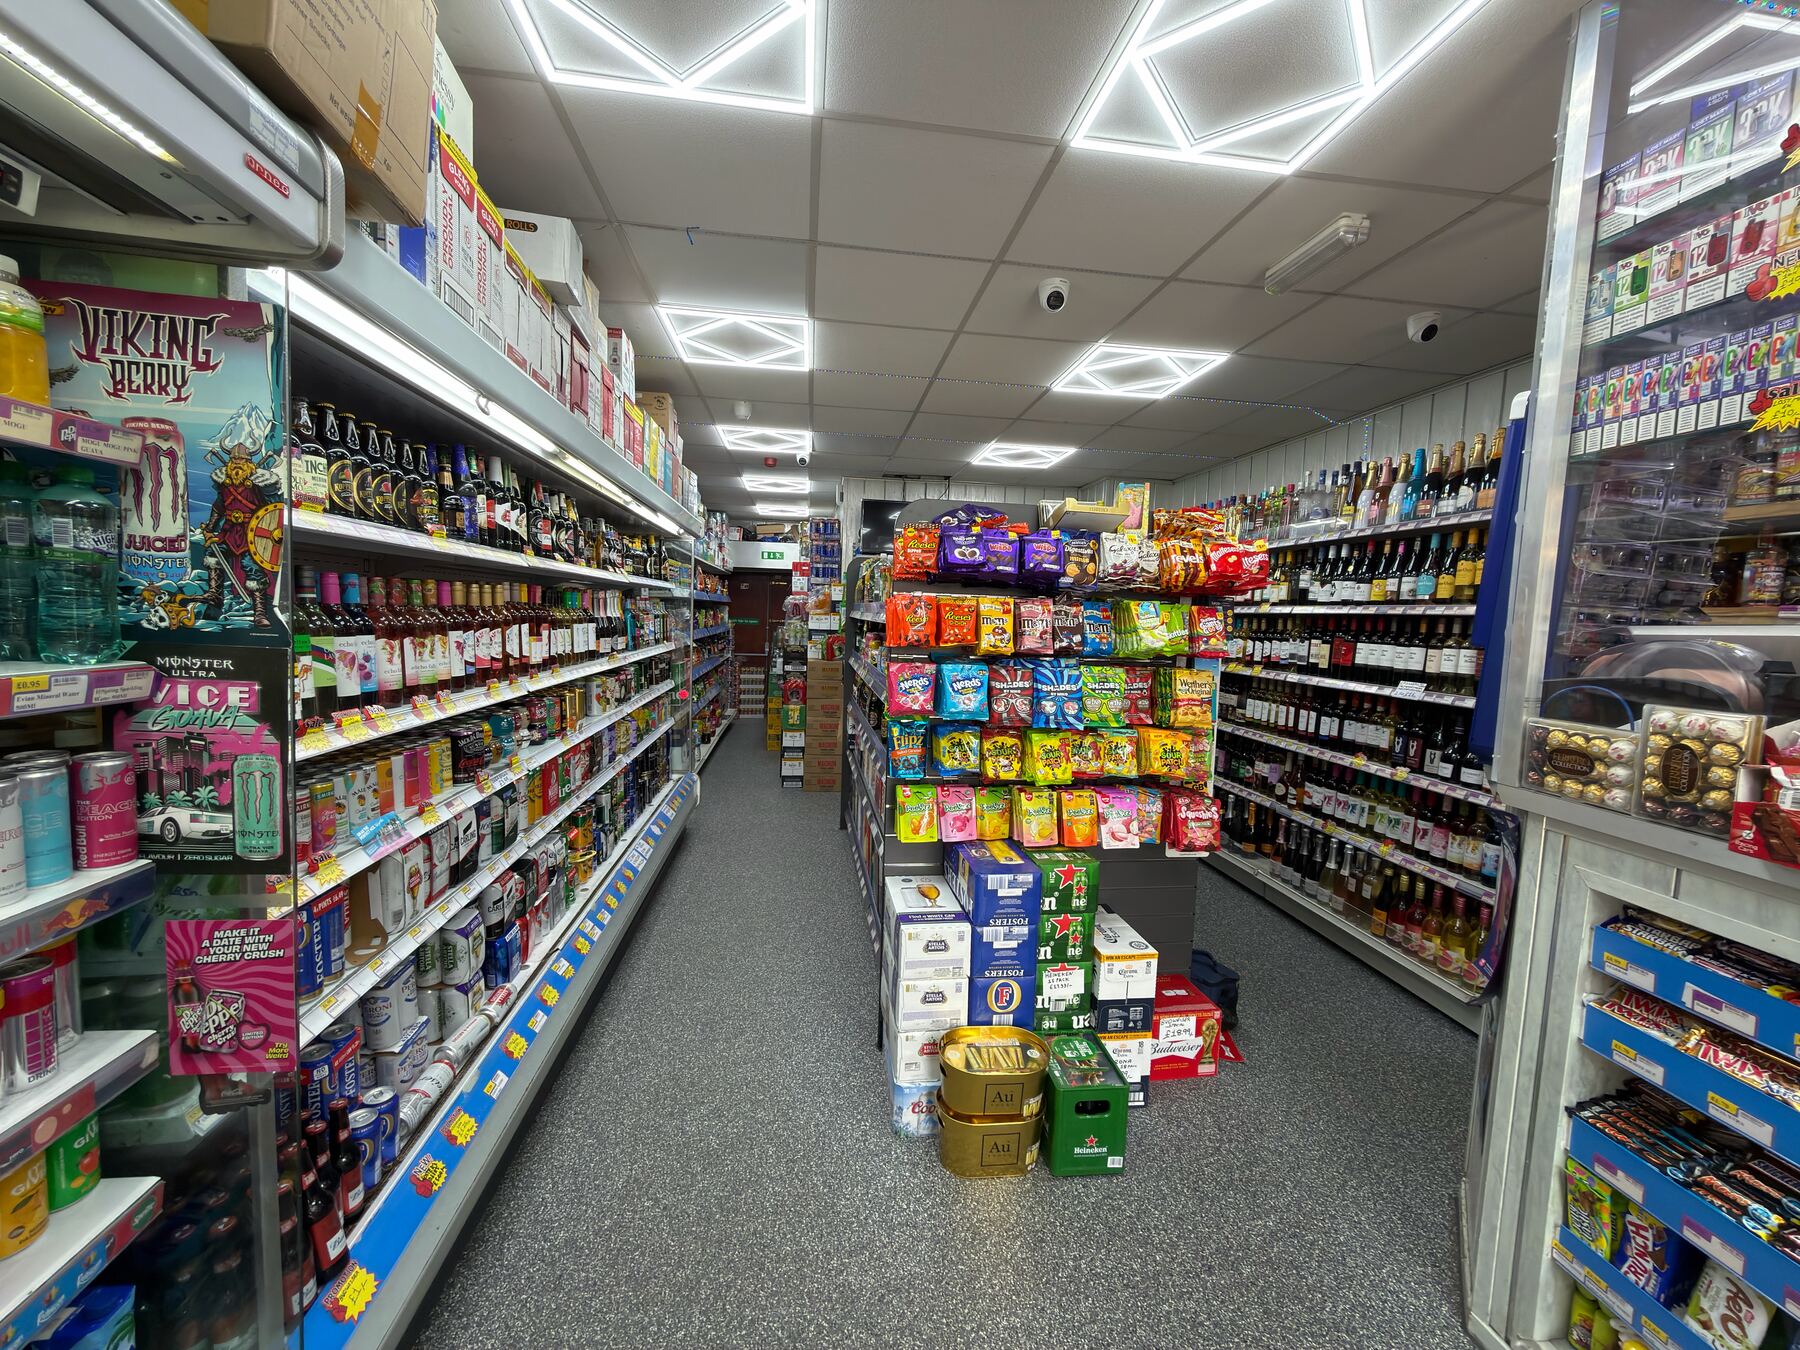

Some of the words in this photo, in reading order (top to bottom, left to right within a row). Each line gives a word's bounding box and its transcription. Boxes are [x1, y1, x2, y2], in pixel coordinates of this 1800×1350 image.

[441, 183, 449, 265] PROUDLY
[506, 219, 535, 232] ROLLS
[446, 193, 454, 270] ORIGINAL
[62, 297, 231, 376] VIKING
[102, 357, 194, 406] BERRY
[126, 421, 149, 429] VIKING
[125, 533, 187, 552] JUICED
[907, 540, 936, 549] Reese's
[989, 542, 1012, 552] Wispa
[1171, 553, 1204, 564] revels
[944, 612, 971, 621] Reese's
[157, 656, 234, 670] MONSTER
[172, 670, 217, 678] ULTRA
[16, 681, 41, 690] £0.95
[995, 681, 1031, 689] SHADES
[1041, 684, 1077, 692] SHADES
[1179, 678, 1212, 688] Werther's
[16, 693, 34, 702] Evian
[35, 692, 61, 700] Mineral
[153, 684, 250, 707] VICE
[1187, 689, 1212, 697] Original
[149, 704, 240, 730] GUAVA
[893, 735, 924, 749] Flipz
[1040, 751, 1062, 759] SOUR
[1160, 751, 1182, 759] SOUR
[77, 825, 88, 847] Bull
[77, 847, 88, 868] Red
[214, 928, 248, 939] MAKE
[249, 927, 260, 936] IT
[201, 939, 210, 948] A
[212, 937, 242, 947] DATE
[244, 934, 274, 944] WITH
[209, 944, 241, 955] YOUR
[243, 942, 270, 952] NEW
[195, 952, 242, 964] CHERRY
[248, 949, 284, 961] CRUSH
[997, 987, 1012, 1005] F
[273, 1042, 288, 1050] Try
[1151, 1042, 1202, 1056] Budweiser
[1700, 1039, 1771, 1081] TWIX
[992, 1091, 1014, 1103] Au
[989, 1141, 1010, 1153] Au
[414, 1153, 432, 1176] NEW
[324, 1261, 358, 1306] PROMOTION
